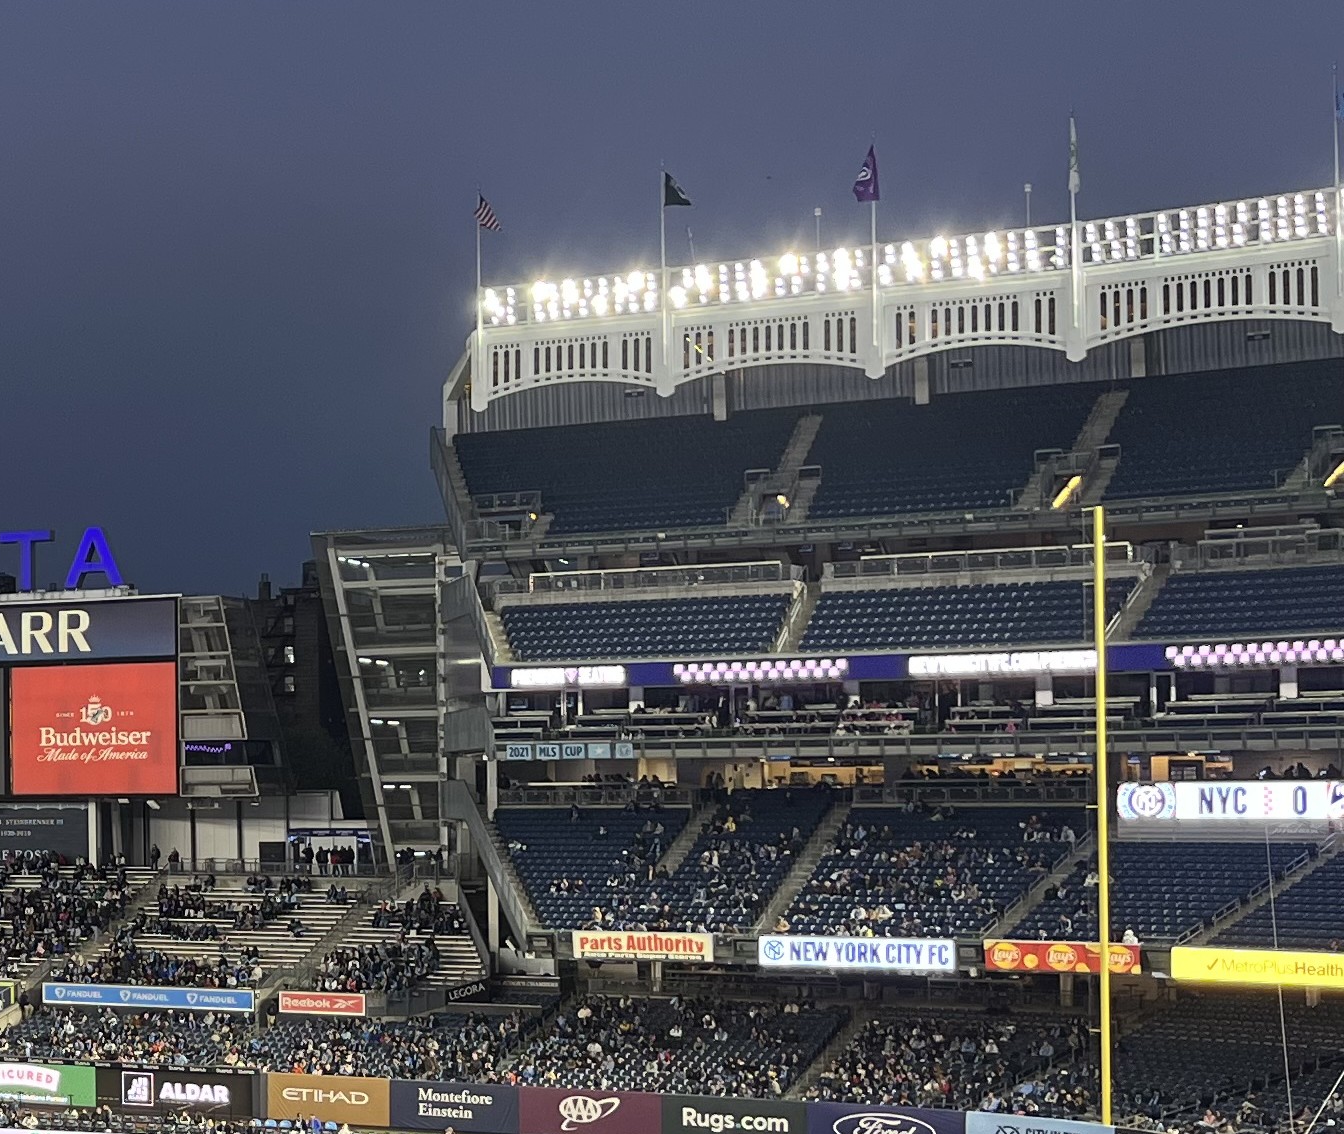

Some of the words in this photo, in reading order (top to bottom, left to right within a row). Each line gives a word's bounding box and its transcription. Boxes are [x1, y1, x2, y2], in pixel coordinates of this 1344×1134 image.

[39, 727, 151, 746] Budweiser
[37, 748, 79, 763] Made
[81, 750, 93, 763] of
[90, 747, 148, 761] America
[509, 747, 529, 757] 2021
[539, 746, 557, 757] MLS
[564, 746, 582, 756] CUP
[1199, 787, 1247, 814] NYC
[1293, 786, 1307, 814] 0
[580, 937, 622, 950] Parts
[626, 934, 704, 954] Authority
[789, 940, 839, 964] NEW
[834, 943, 879, 964] YORK
[885, 943, 922, 965] CITY
[928, 944, 949, 966] FC
[66, 990, 102, 998] FANDUEL
[132, 993, 168, 1001] FANDUEL
[200, 996, 236, 1004] FANDUEL
[448, 982, 486, 1001] LEGORA
[282, 997, 331, 1008] Reebok
[160, 1082, 229, 1102] ALDAR
[282, 1088, 368, 1105] ETIHAD
[418, 1089, 492, 1104] Montefiore
[418, 1104, 473, 1118] Einstein
[559, 1099, 602, 1122] AAA
[682, 1107, 789, 1133] Rugs.com
